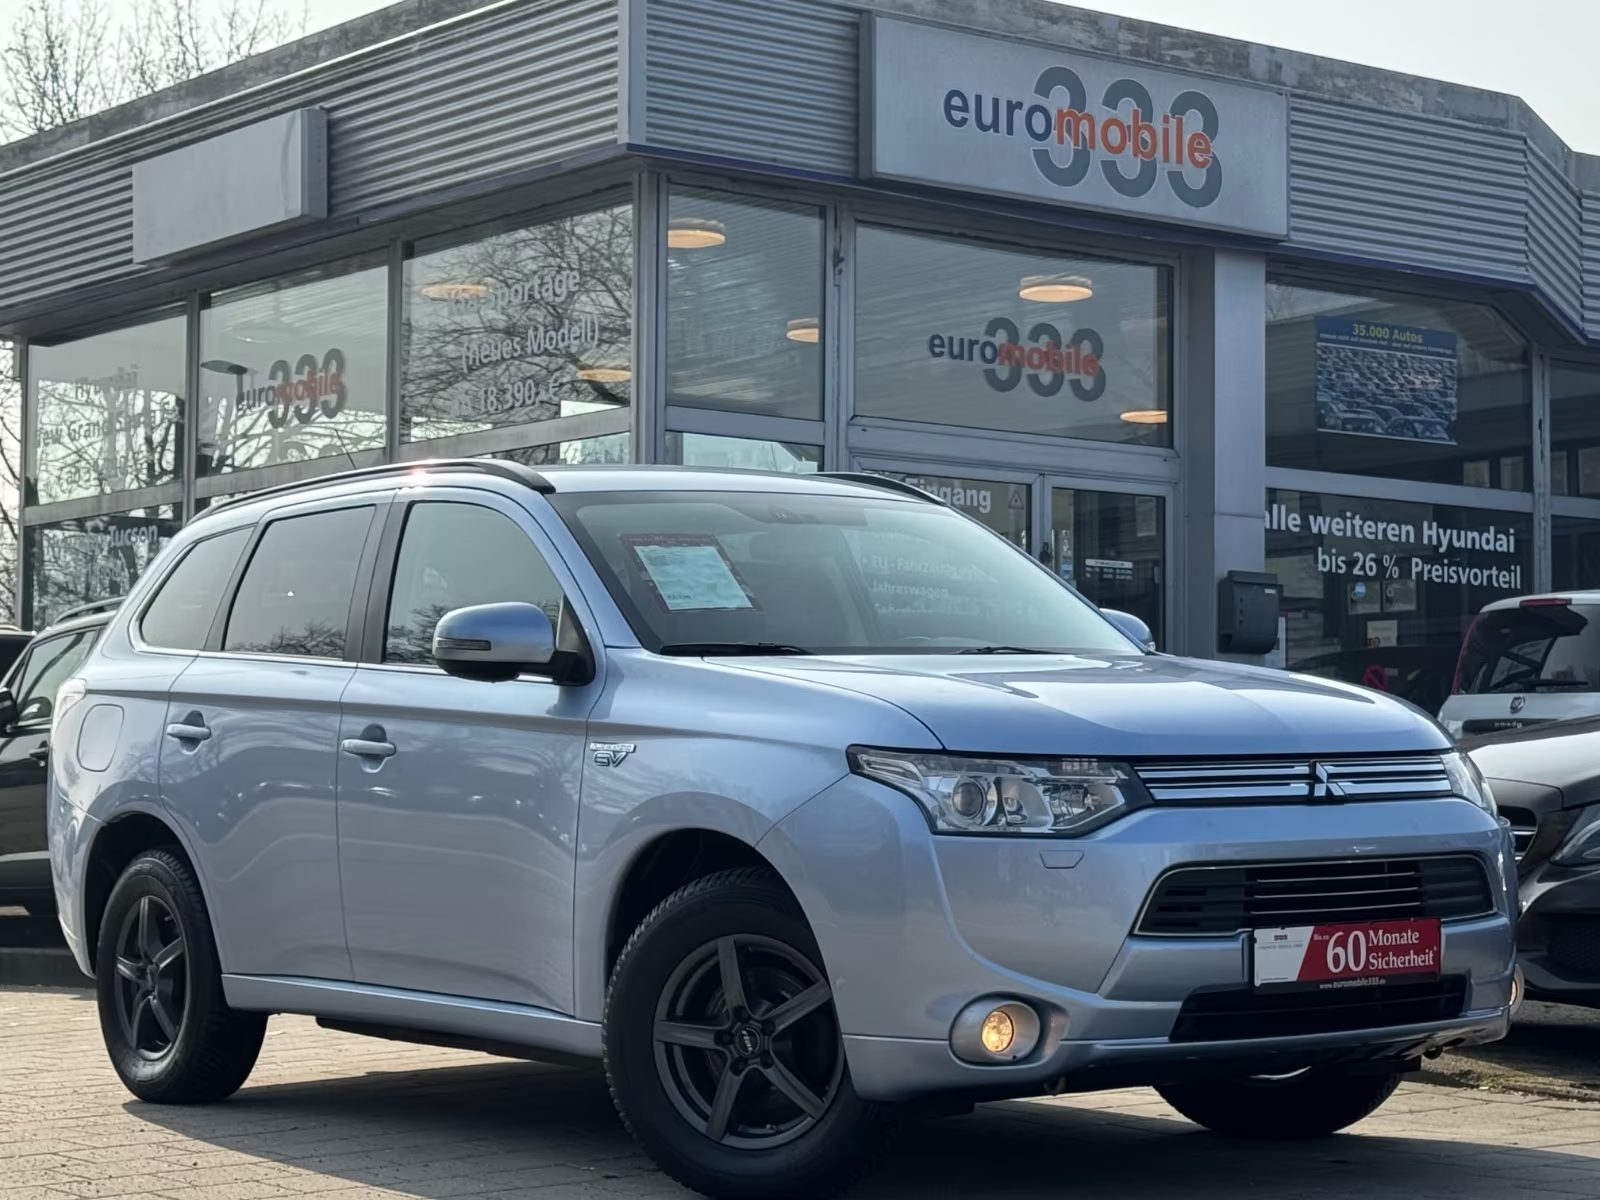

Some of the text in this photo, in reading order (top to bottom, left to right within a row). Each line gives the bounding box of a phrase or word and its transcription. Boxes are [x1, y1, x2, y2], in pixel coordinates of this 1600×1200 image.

[943, 65, 1224, 209] euromobile 333
[487, 269, 581, 311] portage
[527, 314, 600, 356] Modell)
[1352, 323, 1390, 339] 35.000
[1392, 329, 1424, 344] Autos
[928, 316, 1107, 402] euromobile 333
[268, 347, 348, 429] 333
[108, 525, 158, 548] Tucson
[1309, 511, 1415, 544] weiteren
[1422, 520, 1516, 553] Hyundai
[1317, 547, 1522, 590] bis 26 % Preisvorteil
[1326, 930, 1367, 974] 60
[1368, 929, 1420, 947] Monate
